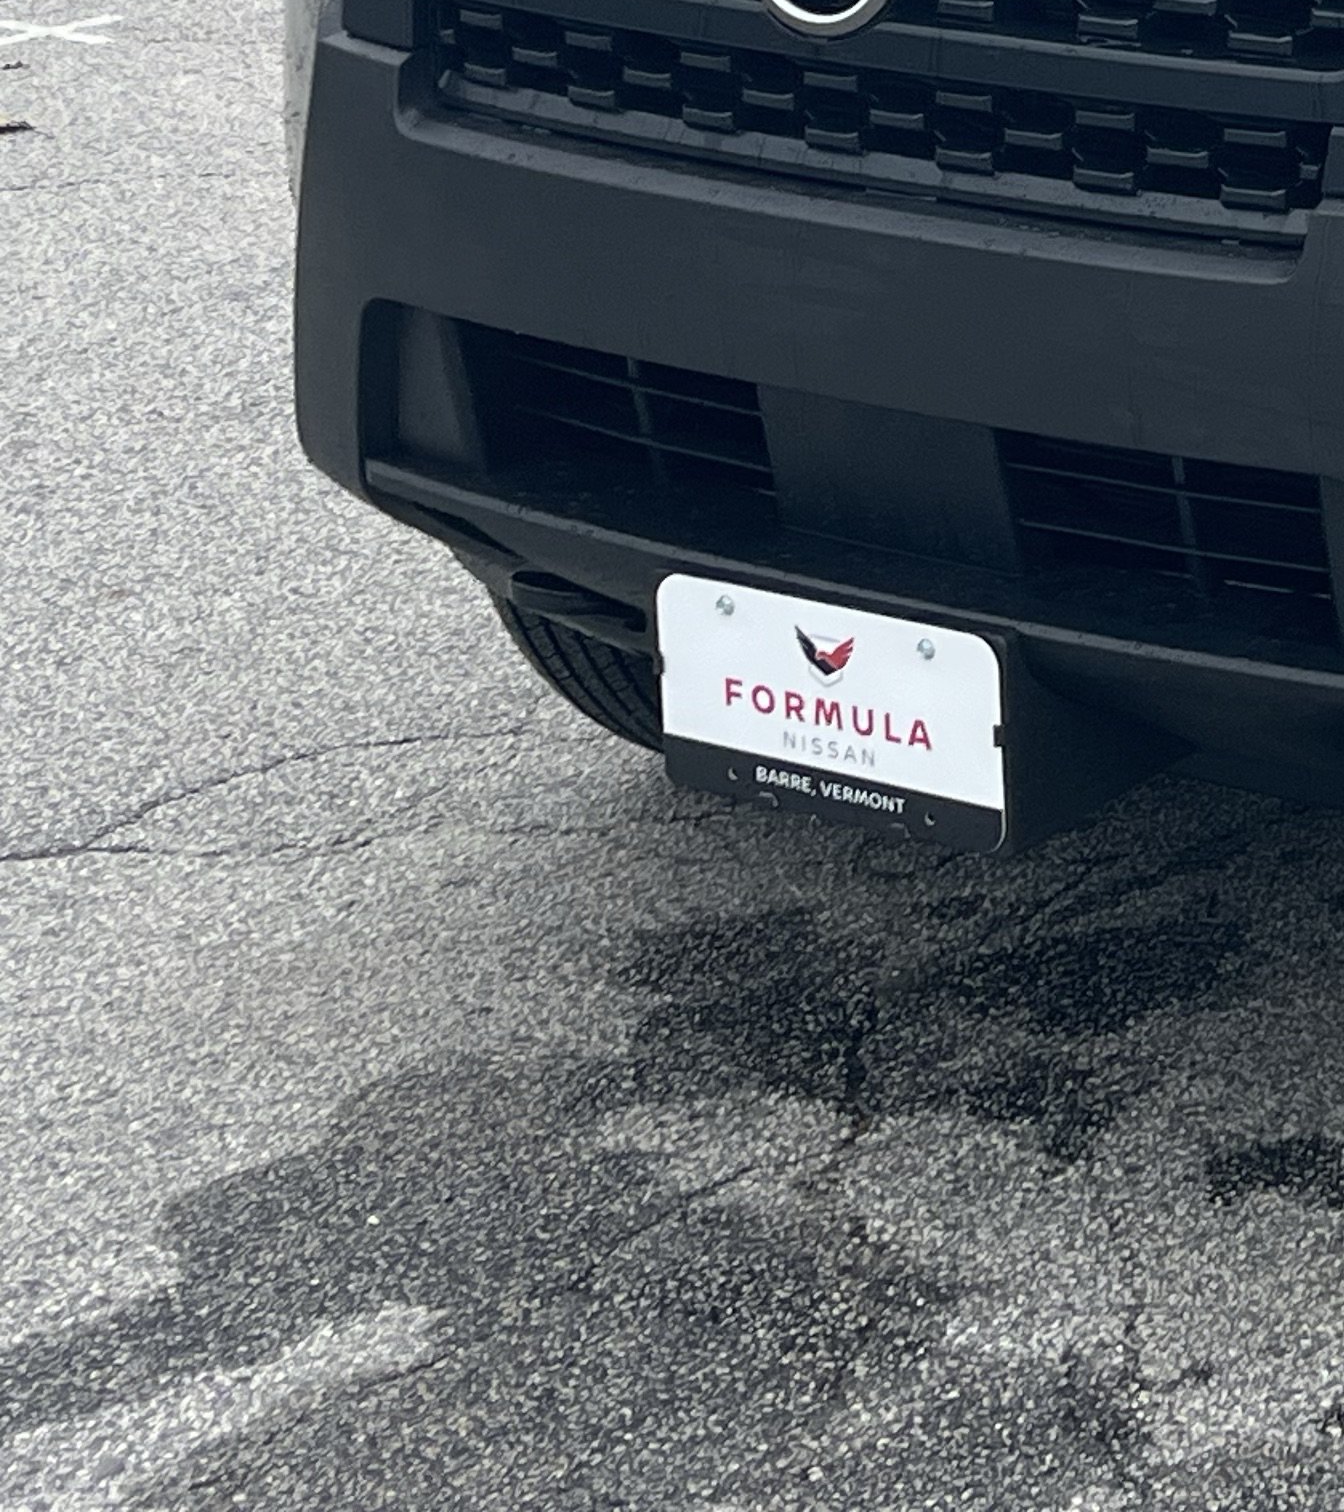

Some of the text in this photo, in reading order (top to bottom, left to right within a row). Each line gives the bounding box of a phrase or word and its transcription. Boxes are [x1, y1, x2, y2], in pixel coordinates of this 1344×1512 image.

[724, 677, 933, 751] FORMULA
[782, 730, 876, 767] NISSAN
[755, 765, 907, 815] BARRE, VERMONT
